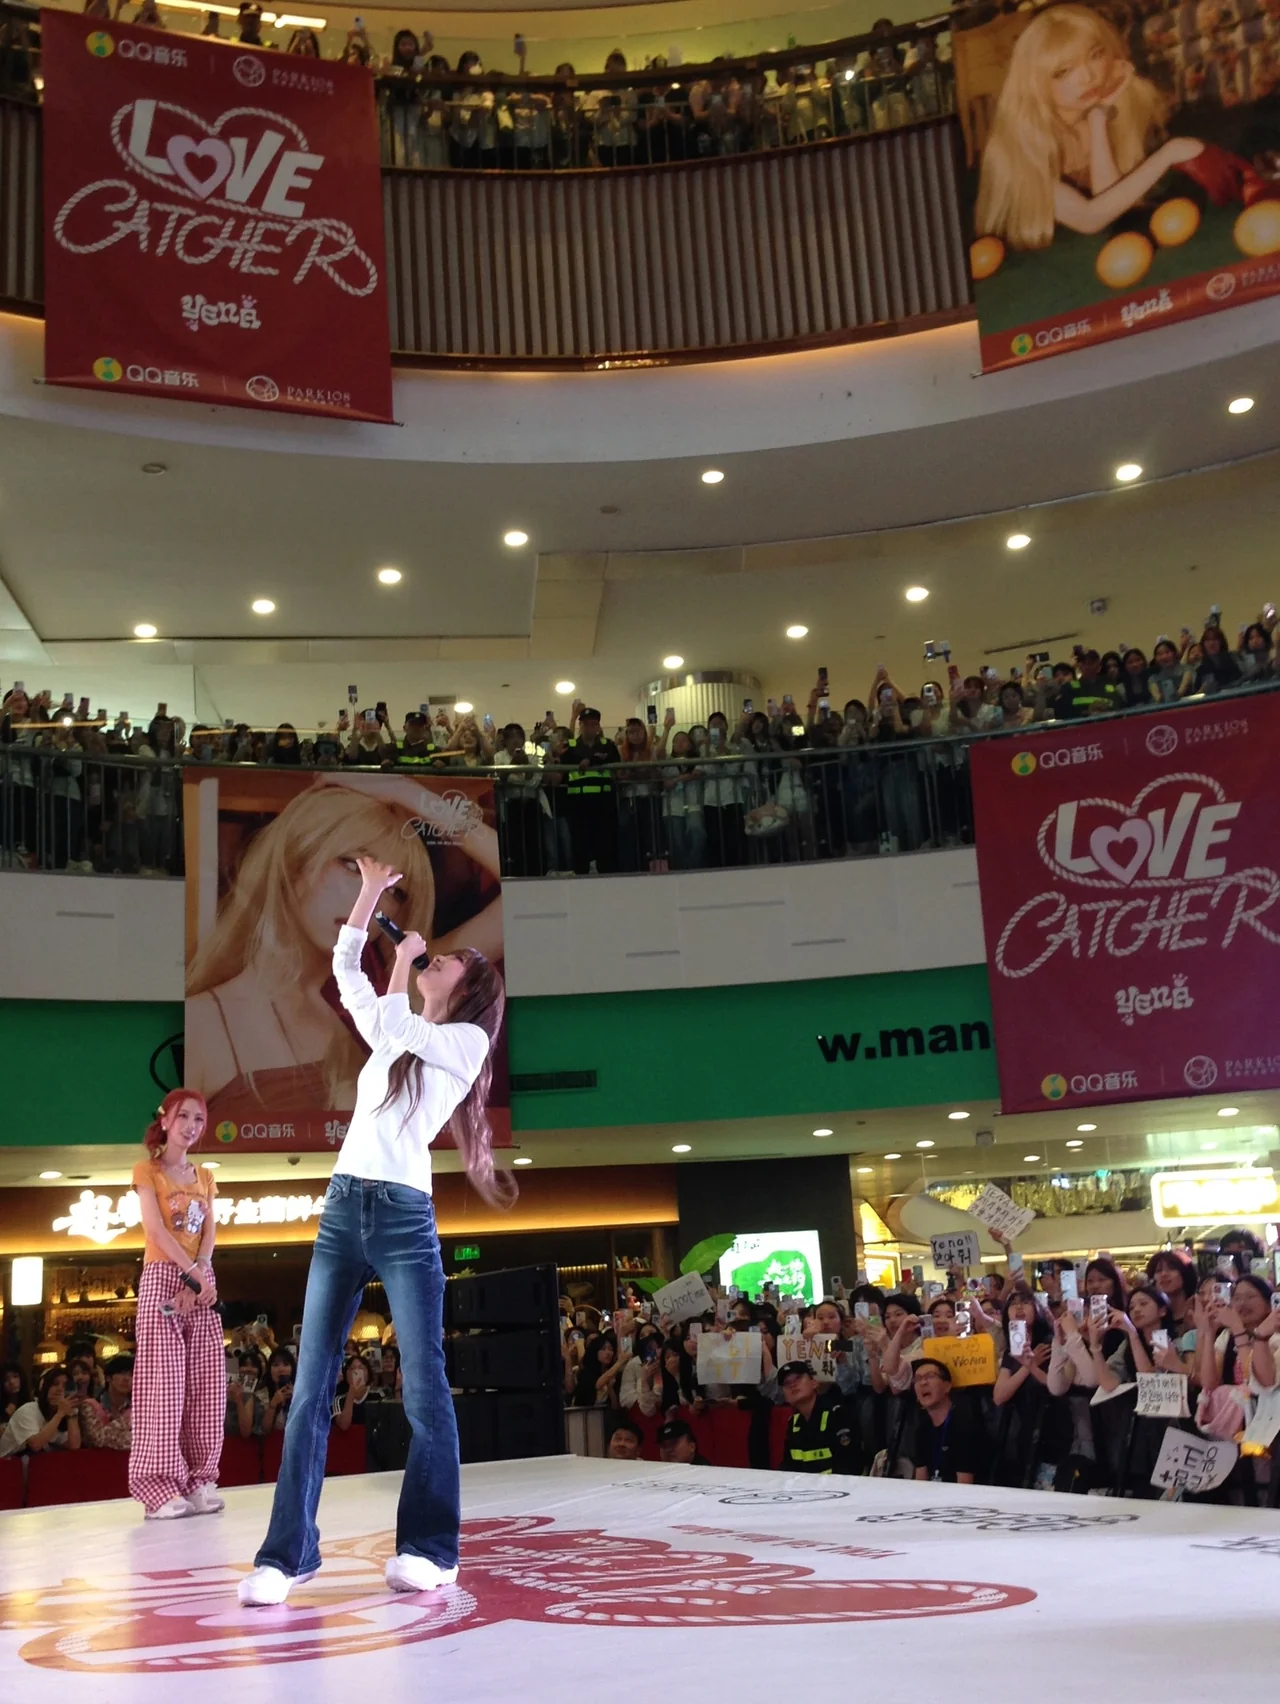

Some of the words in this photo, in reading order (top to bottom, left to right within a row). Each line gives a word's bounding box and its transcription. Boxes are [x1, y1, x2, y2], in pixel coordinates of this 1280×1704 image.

[118, 39, 188, 68] QQ音乐
[54, 178, 378, 298] CATCHER
[1036, 317, 1092, 347] QQ音乐
[126, 364, 200, 389] QQ音乐
[1039, 742, 1104, 769] QQ音乐
[1070, 1069, 1138, 1094] QQ音乐
[240, 1123, 295, 1139] QQ音乐
